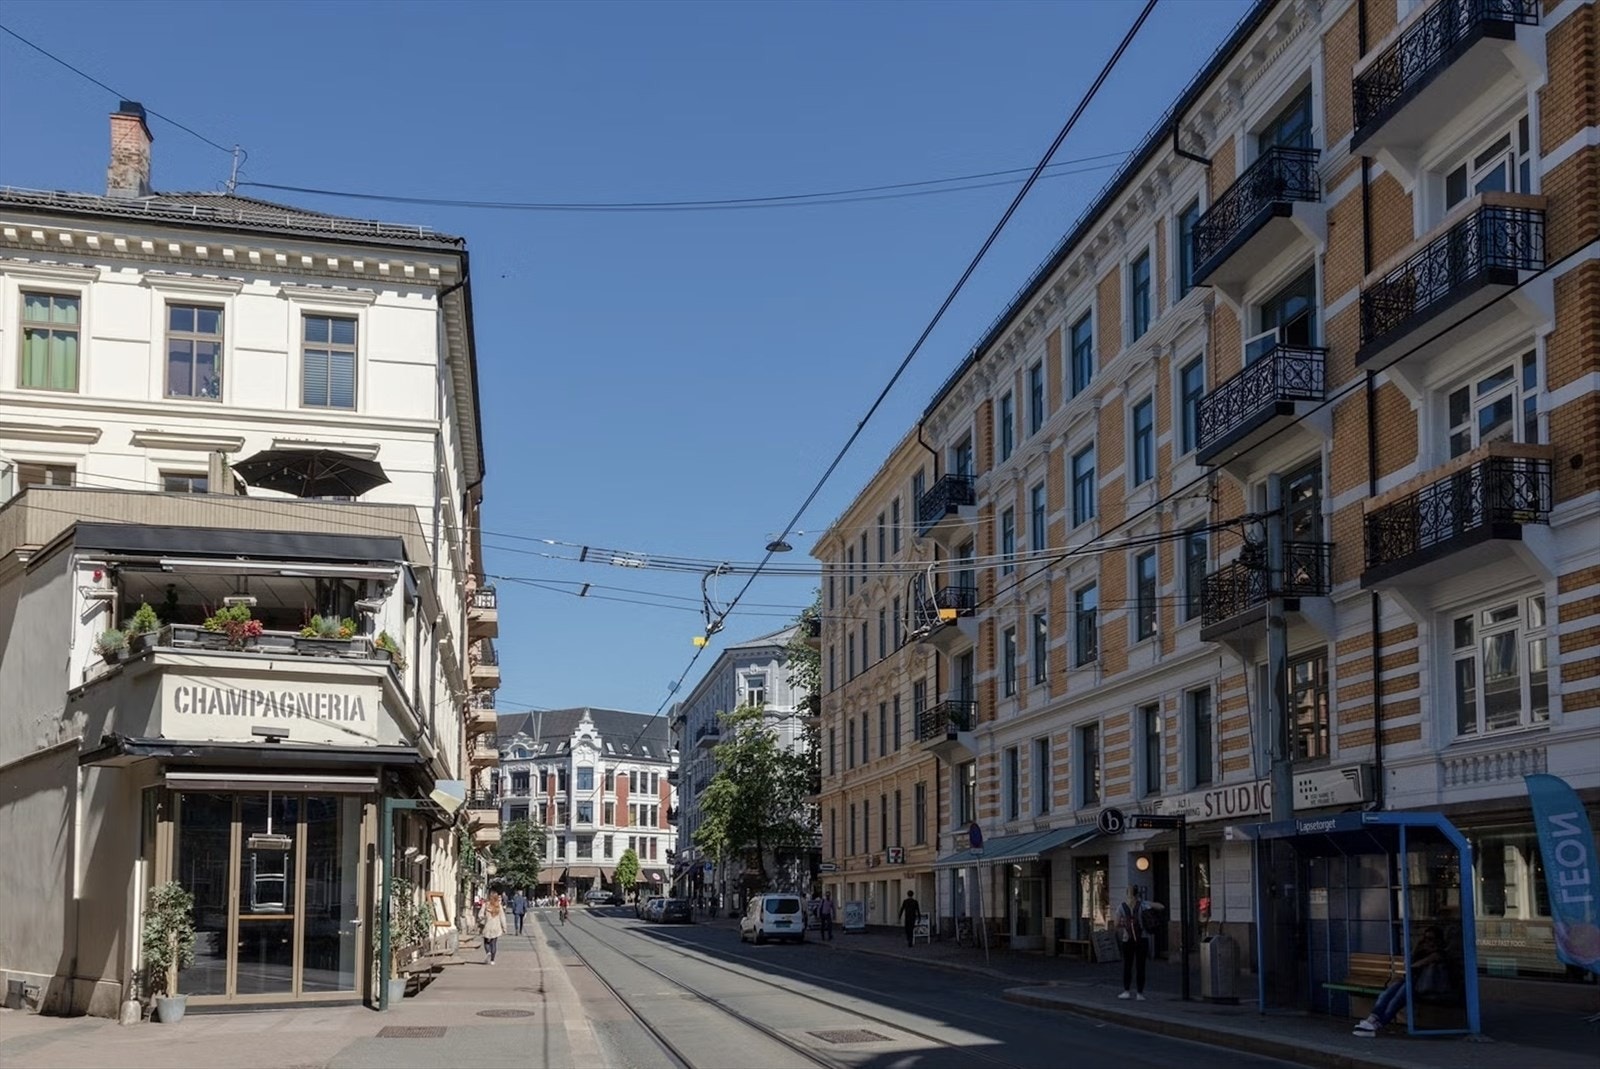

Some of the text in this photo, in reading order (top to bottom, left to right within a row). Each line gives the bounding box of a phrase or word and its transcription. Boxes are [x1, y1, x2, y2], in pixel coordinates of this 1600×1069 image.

[174, 686, 366, 721] CHAMPAGNERIA
[1106, 811, 1120, 831] b
[1299, 818, 1336, 833] Lapsetorget
